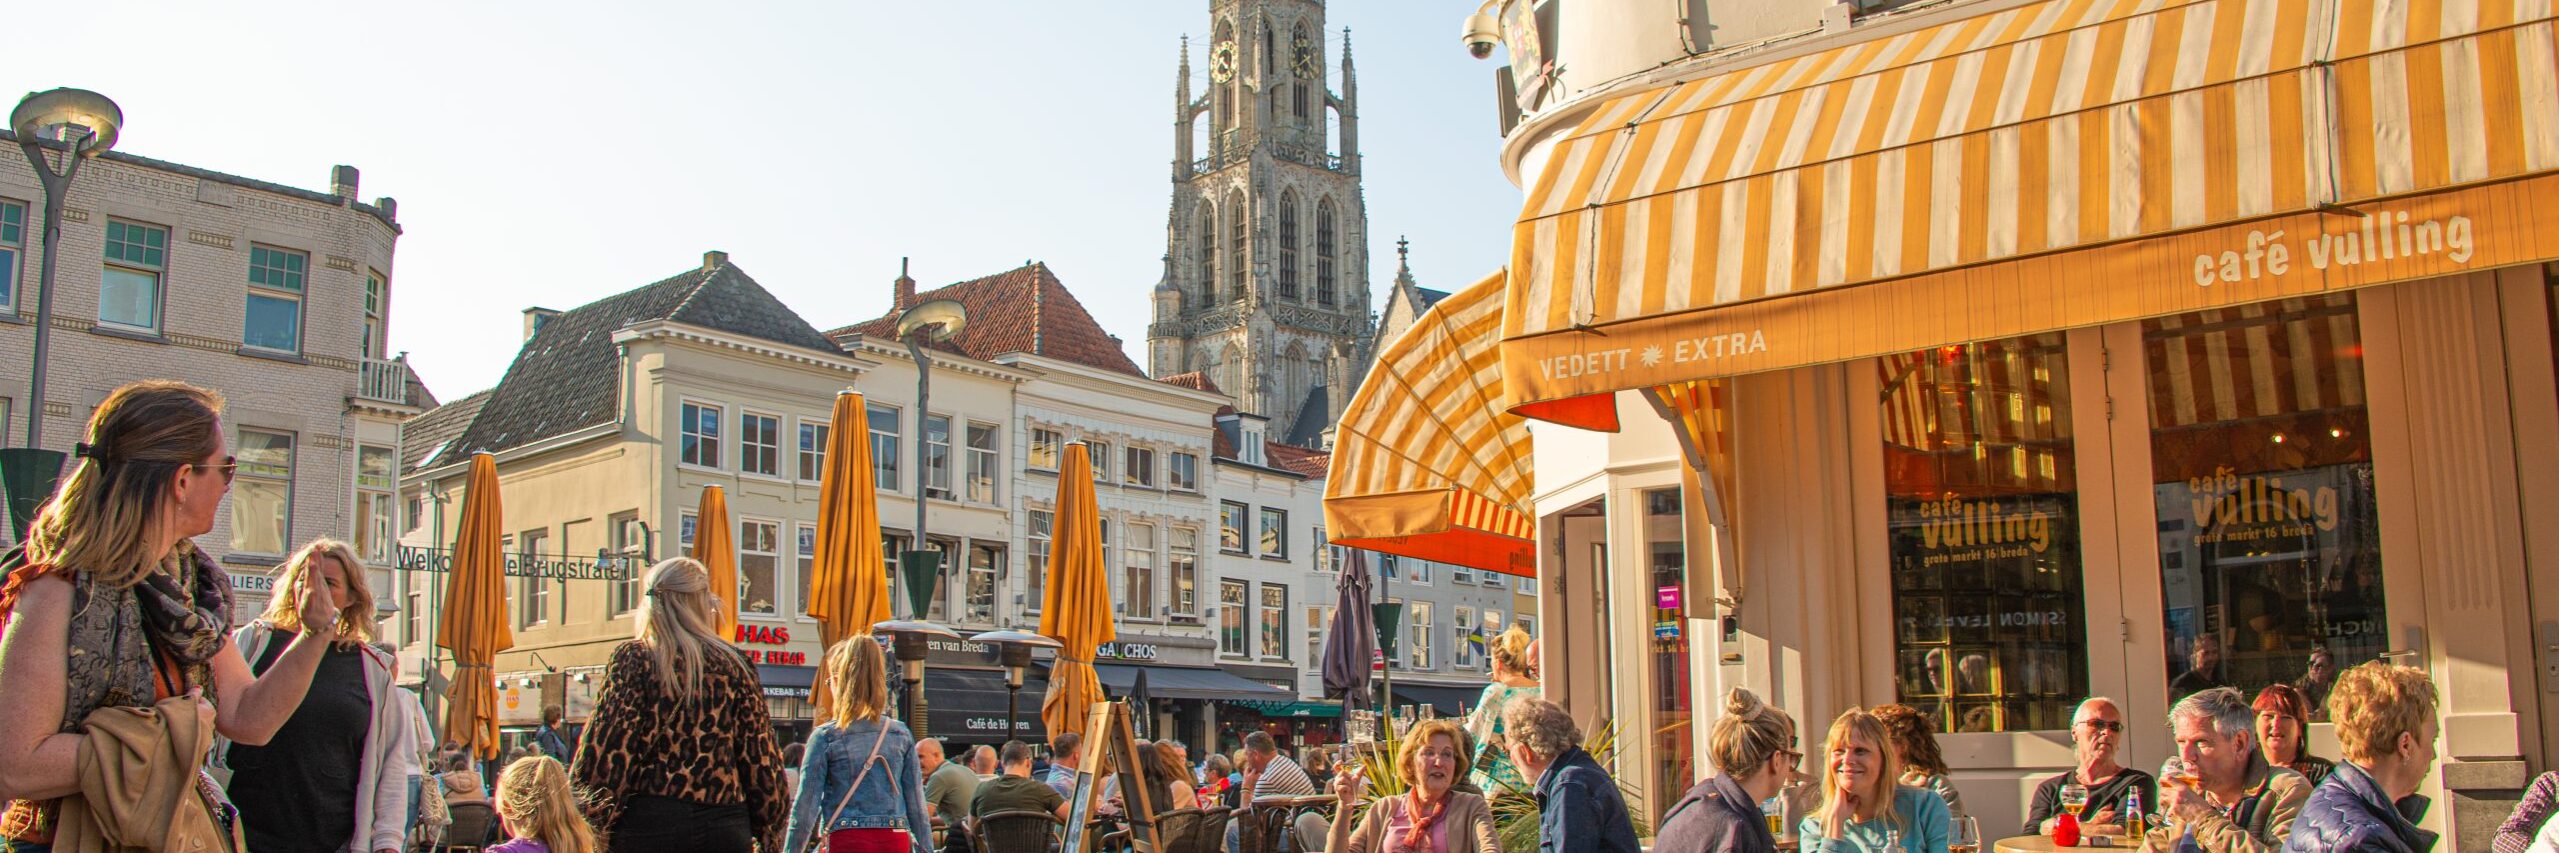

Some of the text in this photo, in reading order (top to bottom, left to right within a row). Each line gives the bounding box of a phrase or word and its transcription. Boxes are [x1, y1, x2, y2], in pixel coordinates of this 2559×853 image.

[2194, 211, 2473, 286] café vulling
[1539, 329, 1767, 381] VEDETT EXTRA
[2189, 466, 2238, 493] café
[1920, 493, 1962, 518] café
[2191, 476, 2338, 531] vulling
[1921, 502, 2049, 552] vulling
[2194, 532, 2222, 547] grote
[2227, 528, 2260, 541] markt
[2264, 527, 2277, 539] 16
[397, 546, 452, 572] Welko
[1924, 546, 2028, 568] grote markt 16 breda
[232, 575, 274, 590] LIERS
[735, 624, 790, 645] HAS
[942, 642, 960, 651] van
[961, 640, 989, 652] Breda
[767, 650, 806, 665] KEBAB
[966, 718, 1030, 730] Café de Hren
